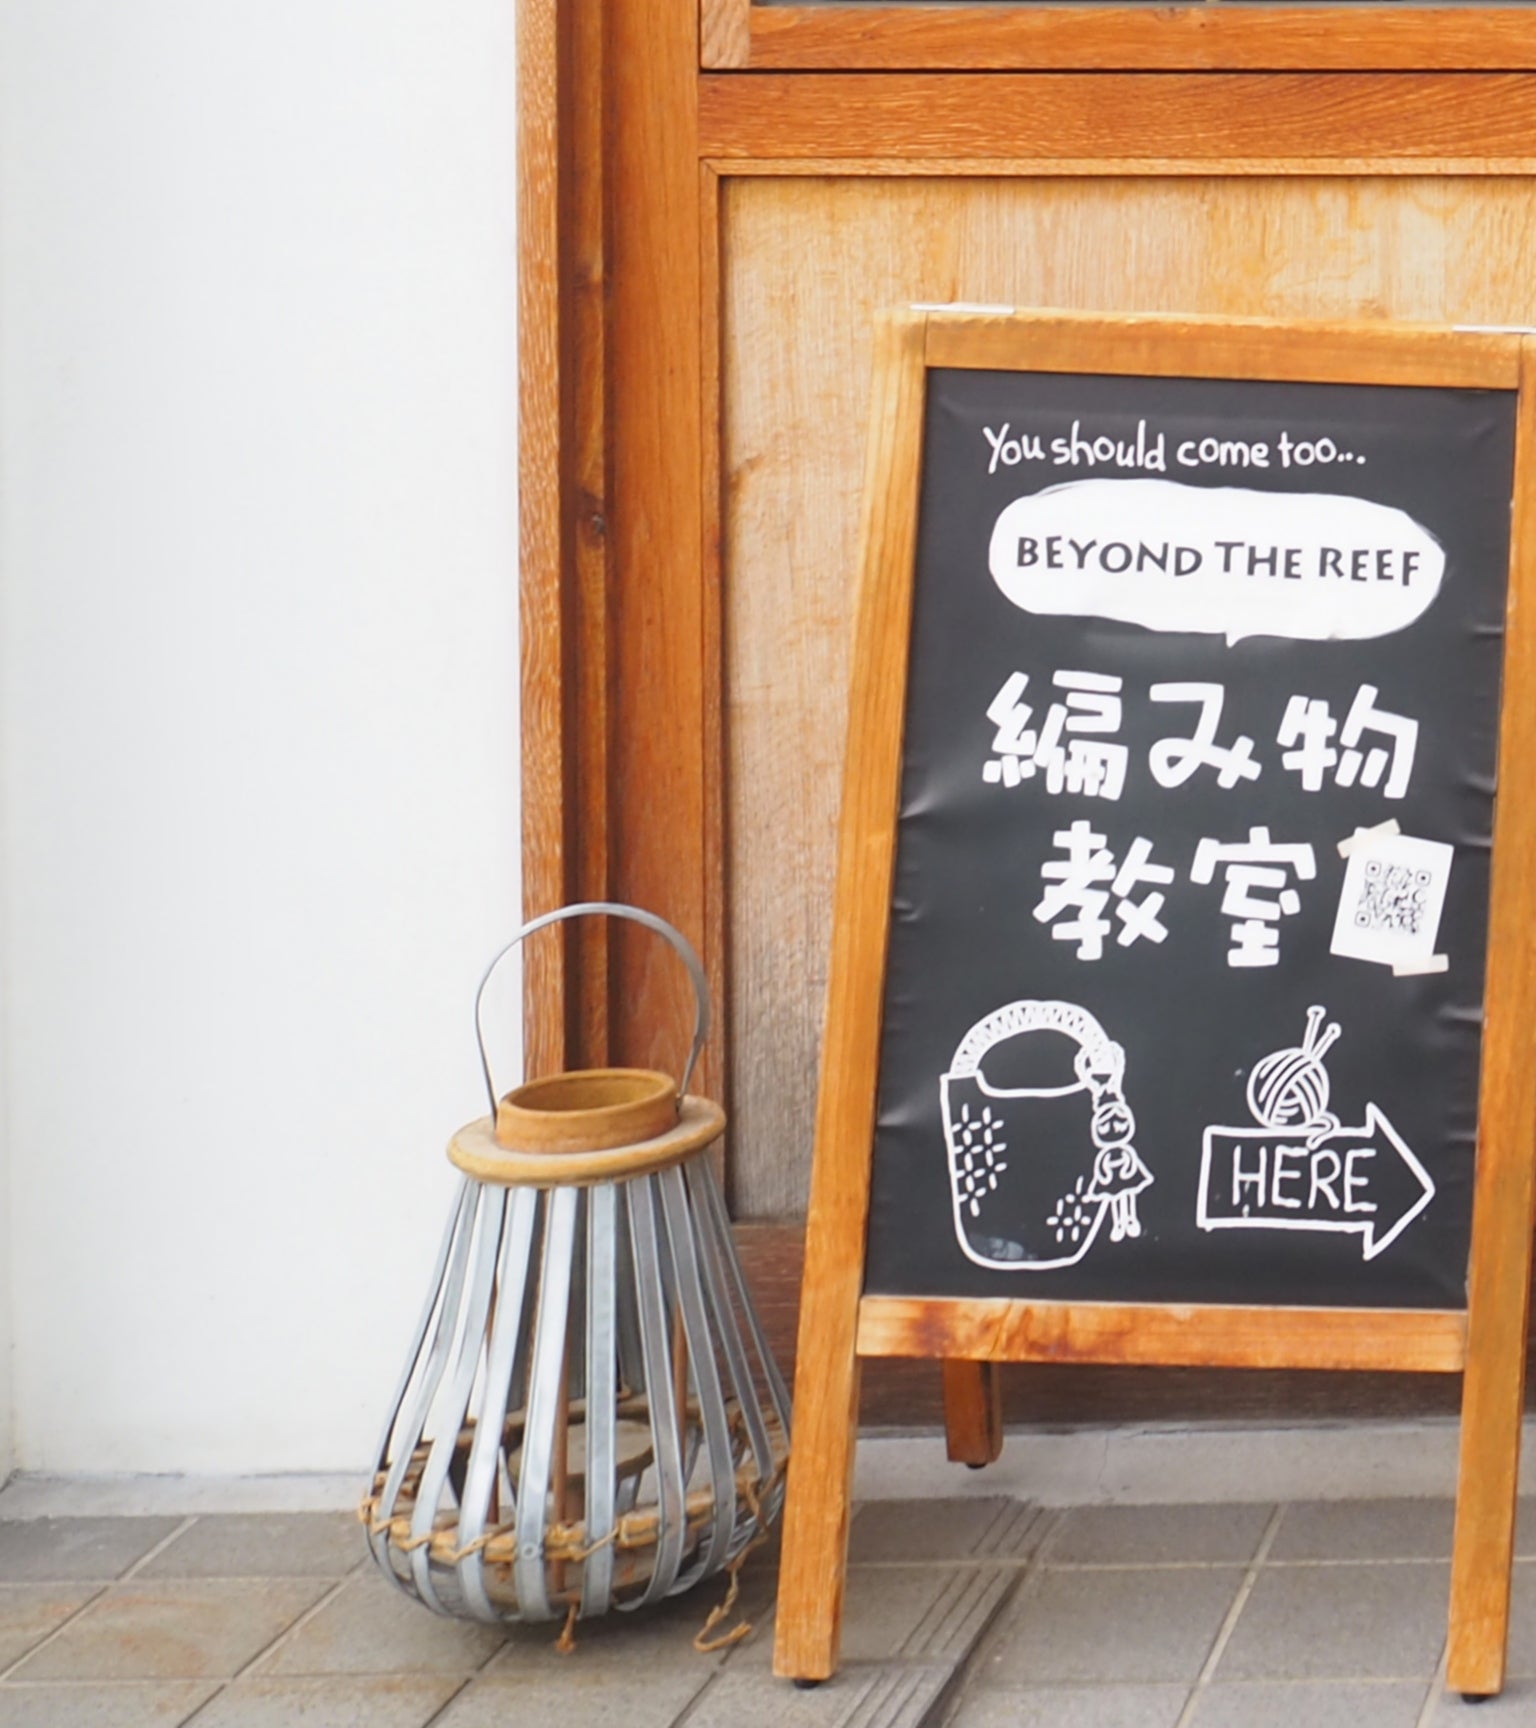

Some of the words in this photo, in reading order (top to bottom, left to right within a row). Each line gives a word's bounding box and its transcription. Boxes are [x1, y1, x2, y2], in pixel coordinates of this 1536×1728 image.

[983, 423, 1046, 474] You
[1051, 419, 1166, 472] should
[1176, 437, 1270, 468] come
[1017, 535, 1203, 577] BEYOND
[1214, 541, 1302, 580] THE
[1319, 547, 1420, 587] REEF
[982, 670, 1419, 801] 編み物
[1032, 820, 1317, 967] 教室
[1232, 1145, 1378, 1213] HERE
